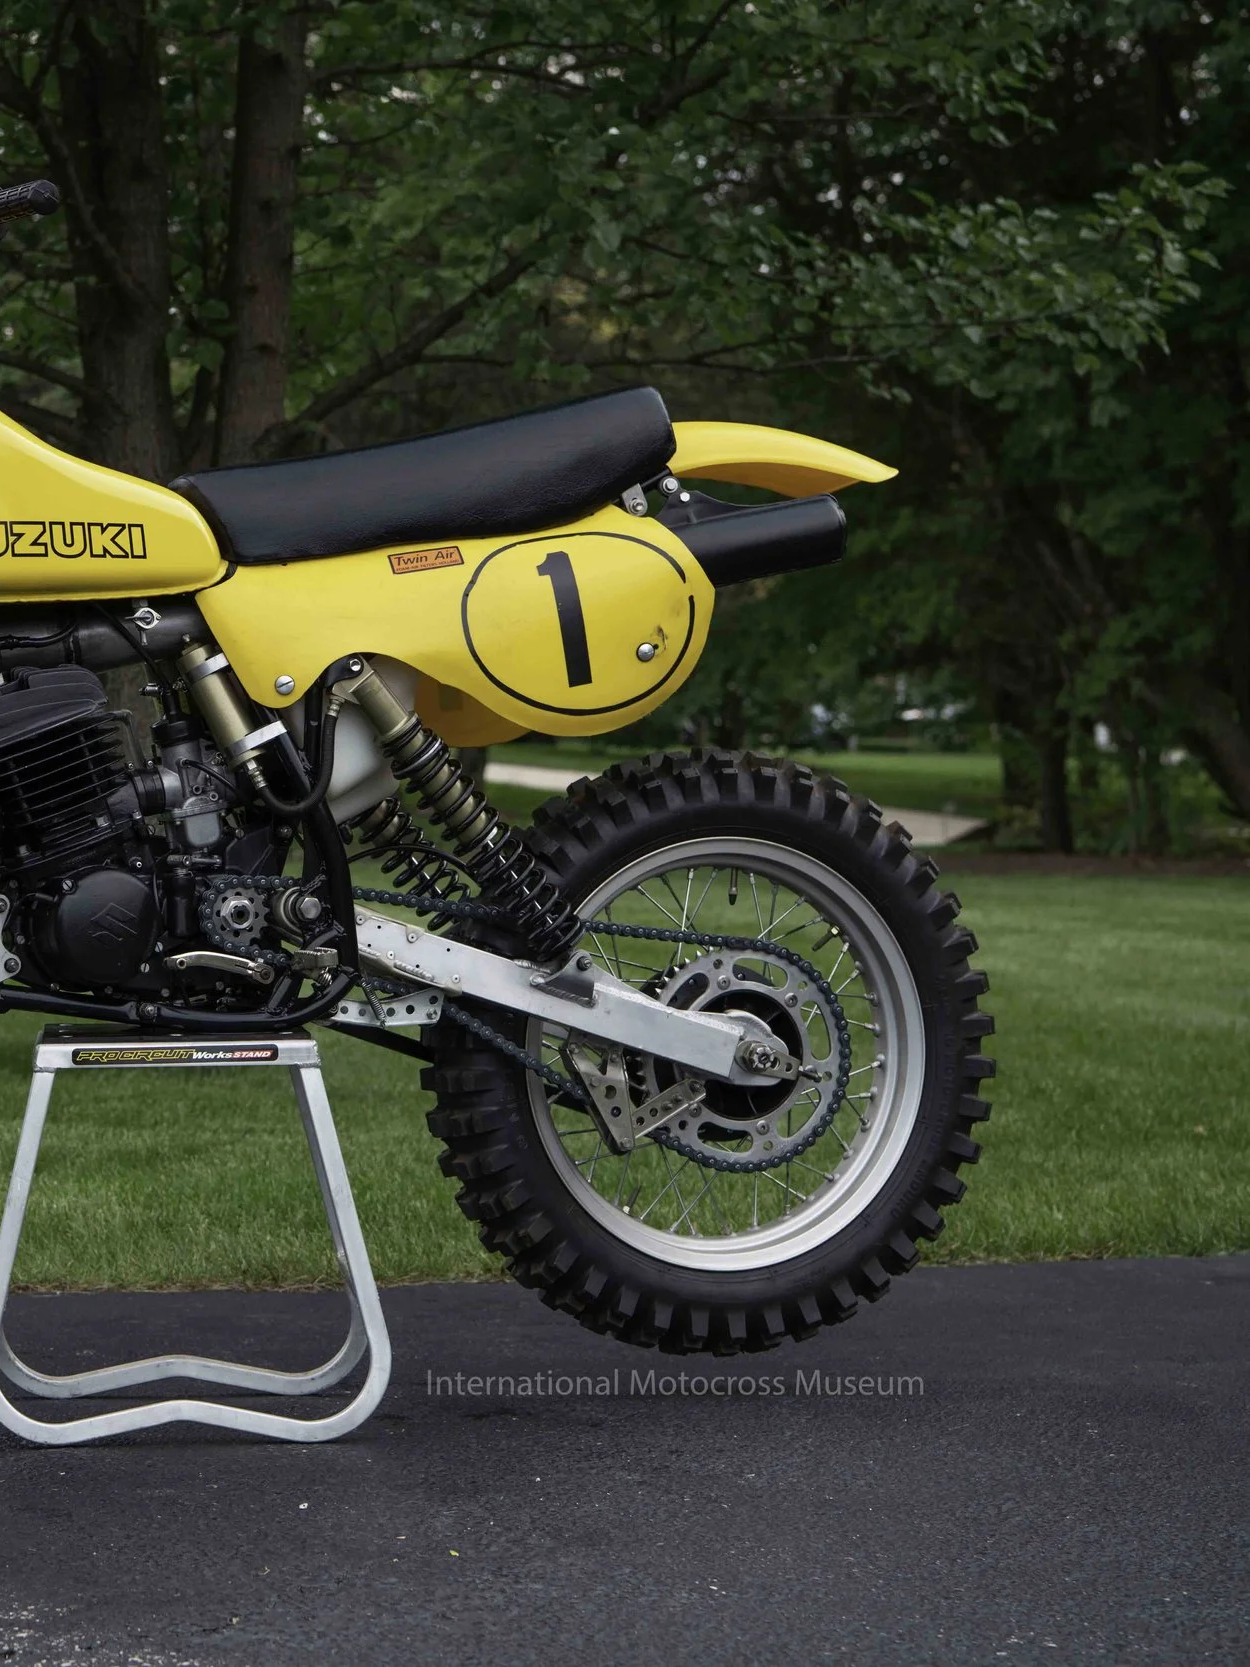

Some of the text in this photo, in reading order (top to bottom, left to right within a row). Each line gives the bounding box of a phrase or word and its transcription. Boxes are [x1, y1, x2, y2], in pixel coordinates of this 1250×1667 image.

[394, 549, 455, 566] Twin Air
[536, 551, 592, 688] 1
[192, 1051, 233, 1059] Works
